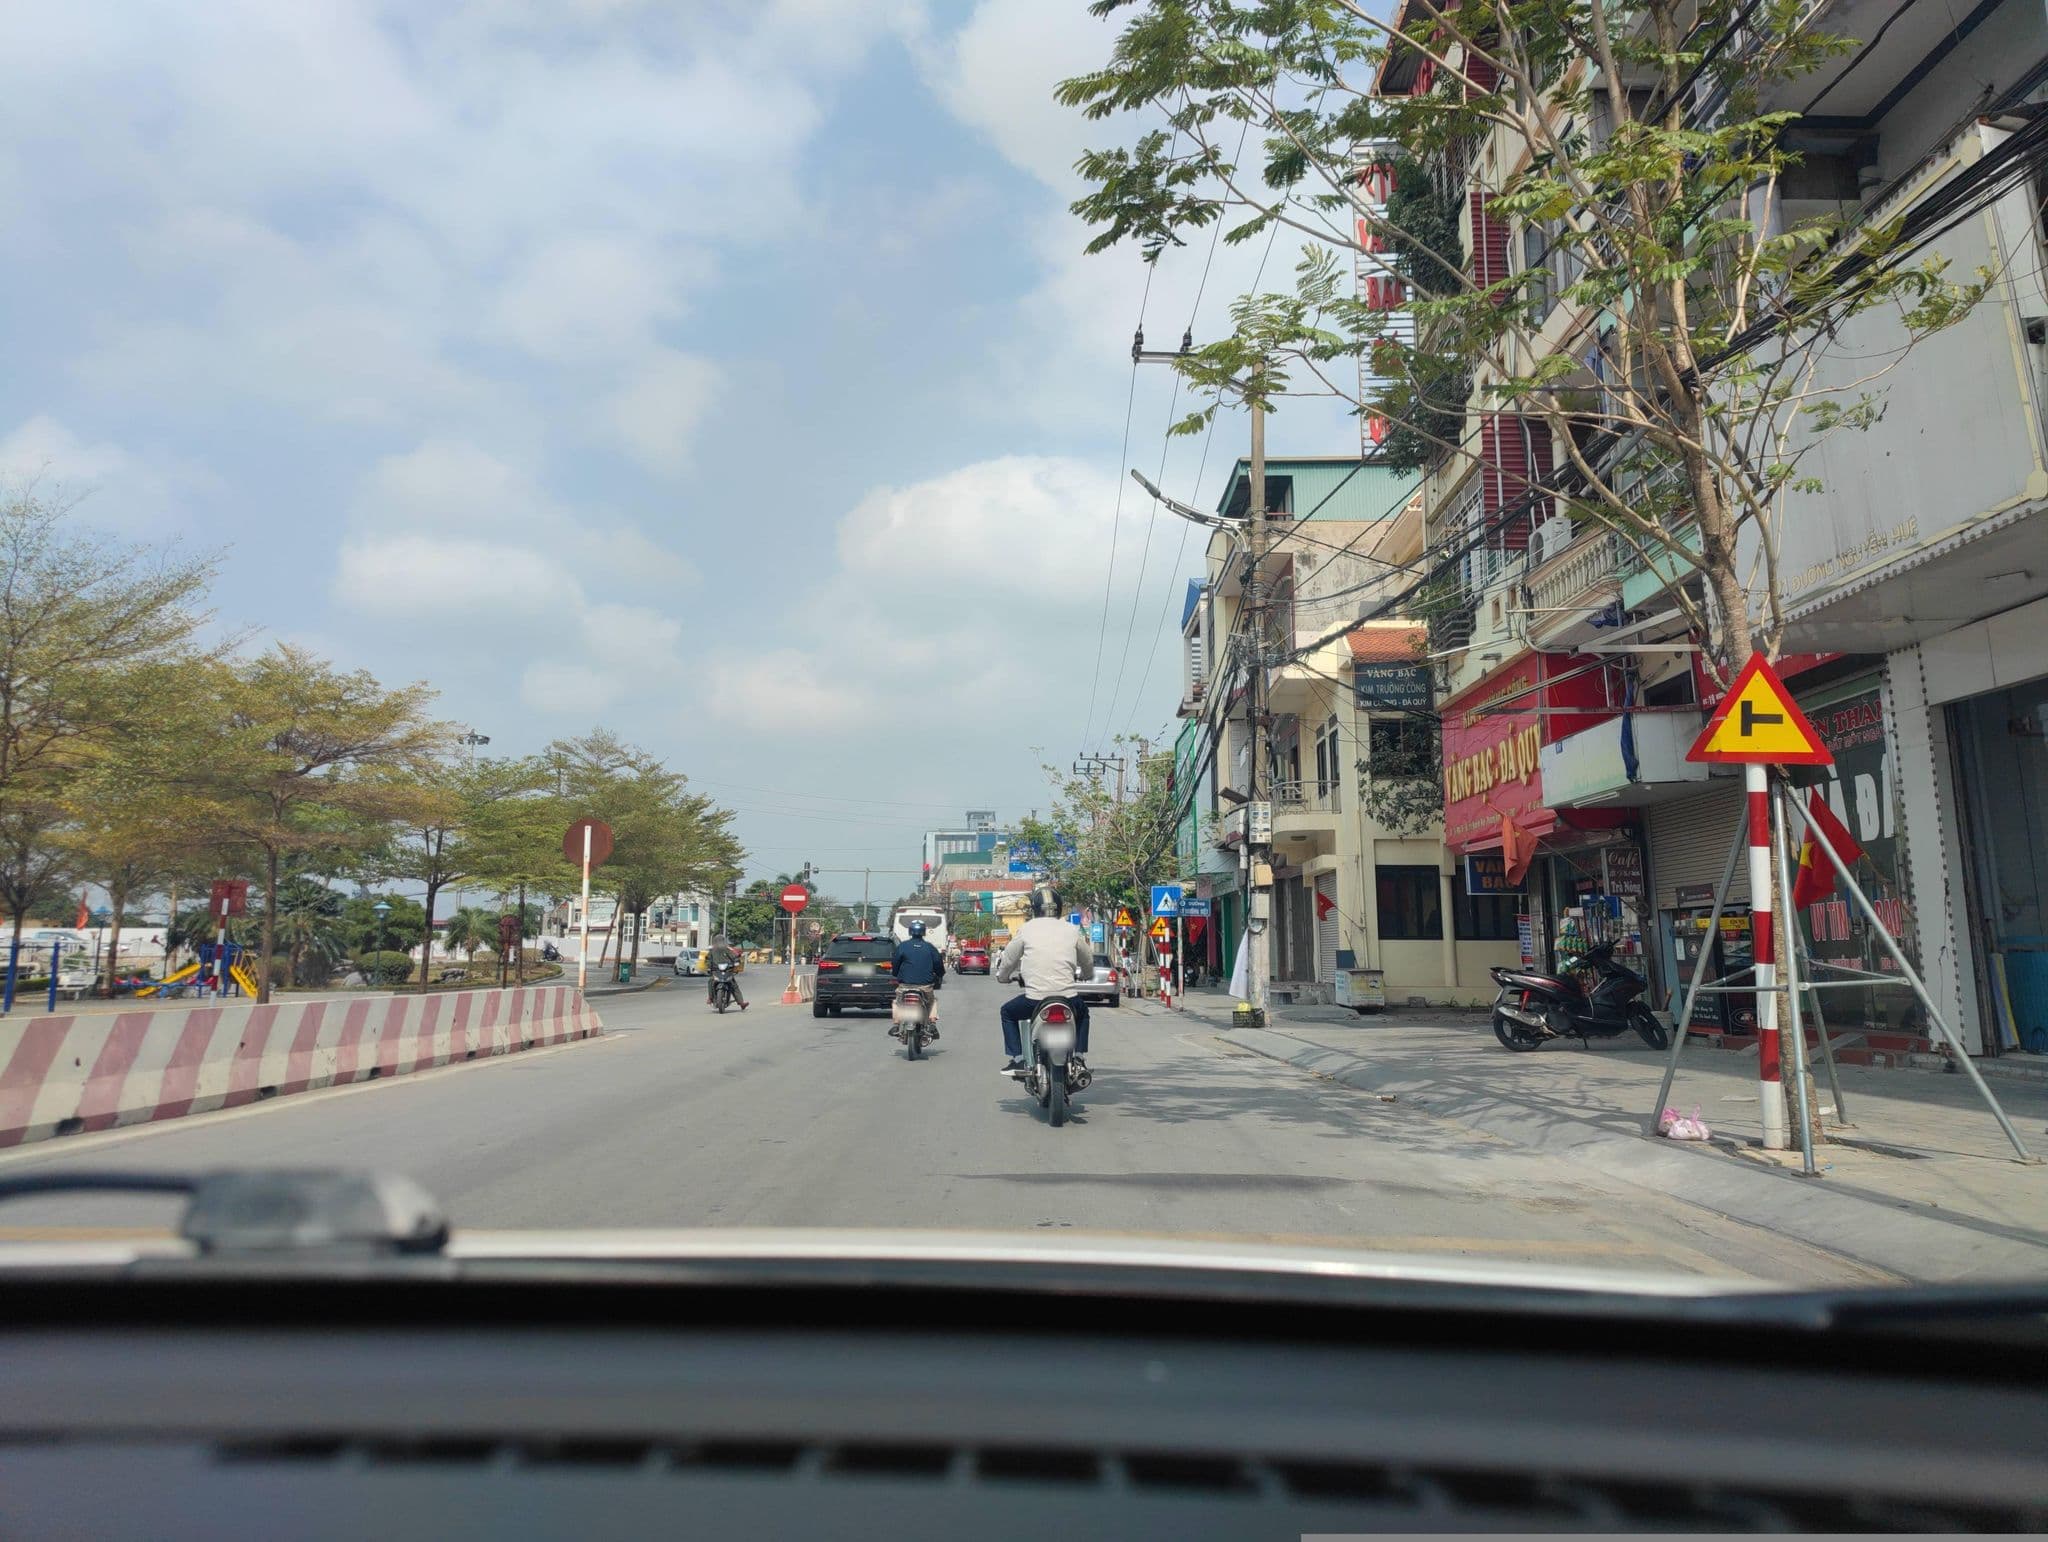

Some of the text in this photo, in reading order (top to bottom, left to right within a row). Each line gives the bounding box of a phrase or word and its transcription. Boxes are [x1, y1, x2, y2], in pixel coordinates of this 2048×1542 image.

[1366, 667, 1394, 678] VÀNG
[1360, 684, 1375, 695] KIM
[1445, 752, 1471, 804] VÀNG
[1472, 747, 1495, 804] BẠC
[1499, 722, 1518, 784] ĐÁ
[1810, 902, 1827, 942] UY
[1827, 891, 1850, 941] TÍN
